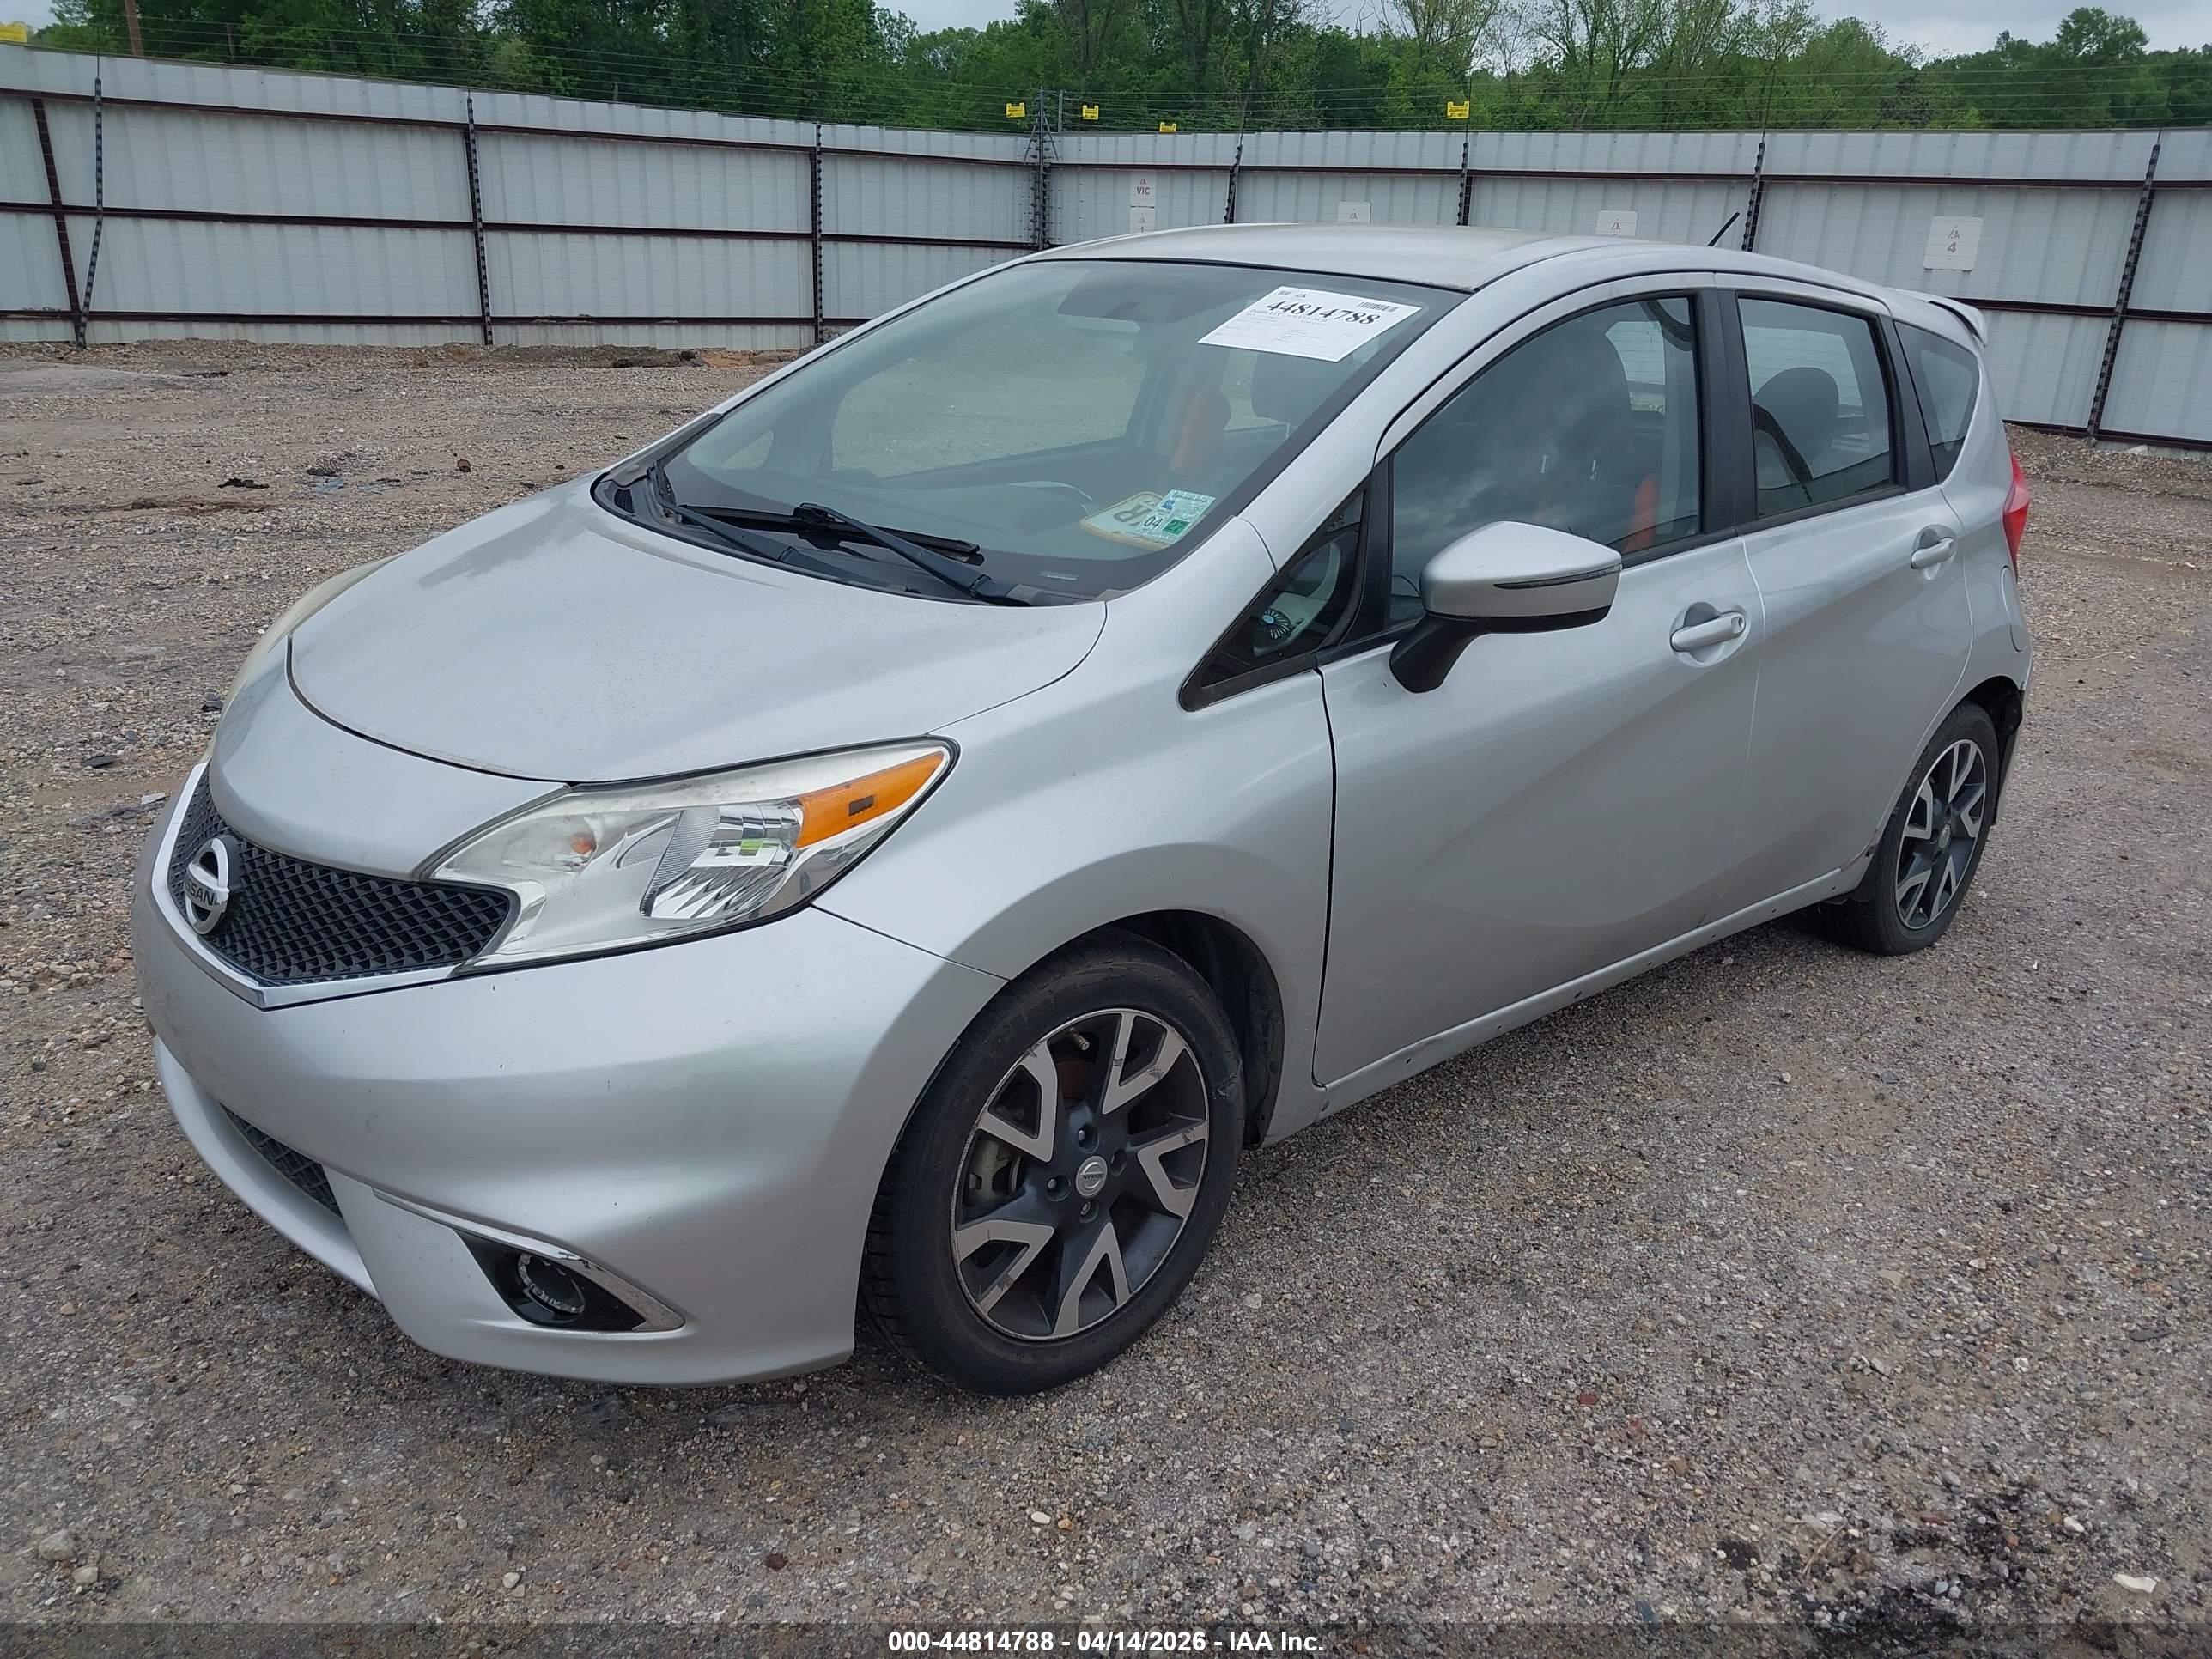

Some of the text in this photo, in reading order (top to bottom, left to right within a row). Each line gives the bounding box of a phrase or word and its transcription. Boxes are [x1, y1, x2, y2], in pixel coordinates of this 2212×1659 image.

[1136, 186, 1151, 196] VIC
[1947, 241, 1957, 253] 4
[1267, 301, 1381, 325] 44814788
[1144, 516, 1164, 529] 04
[1167, 520, 1187, 532] 27
